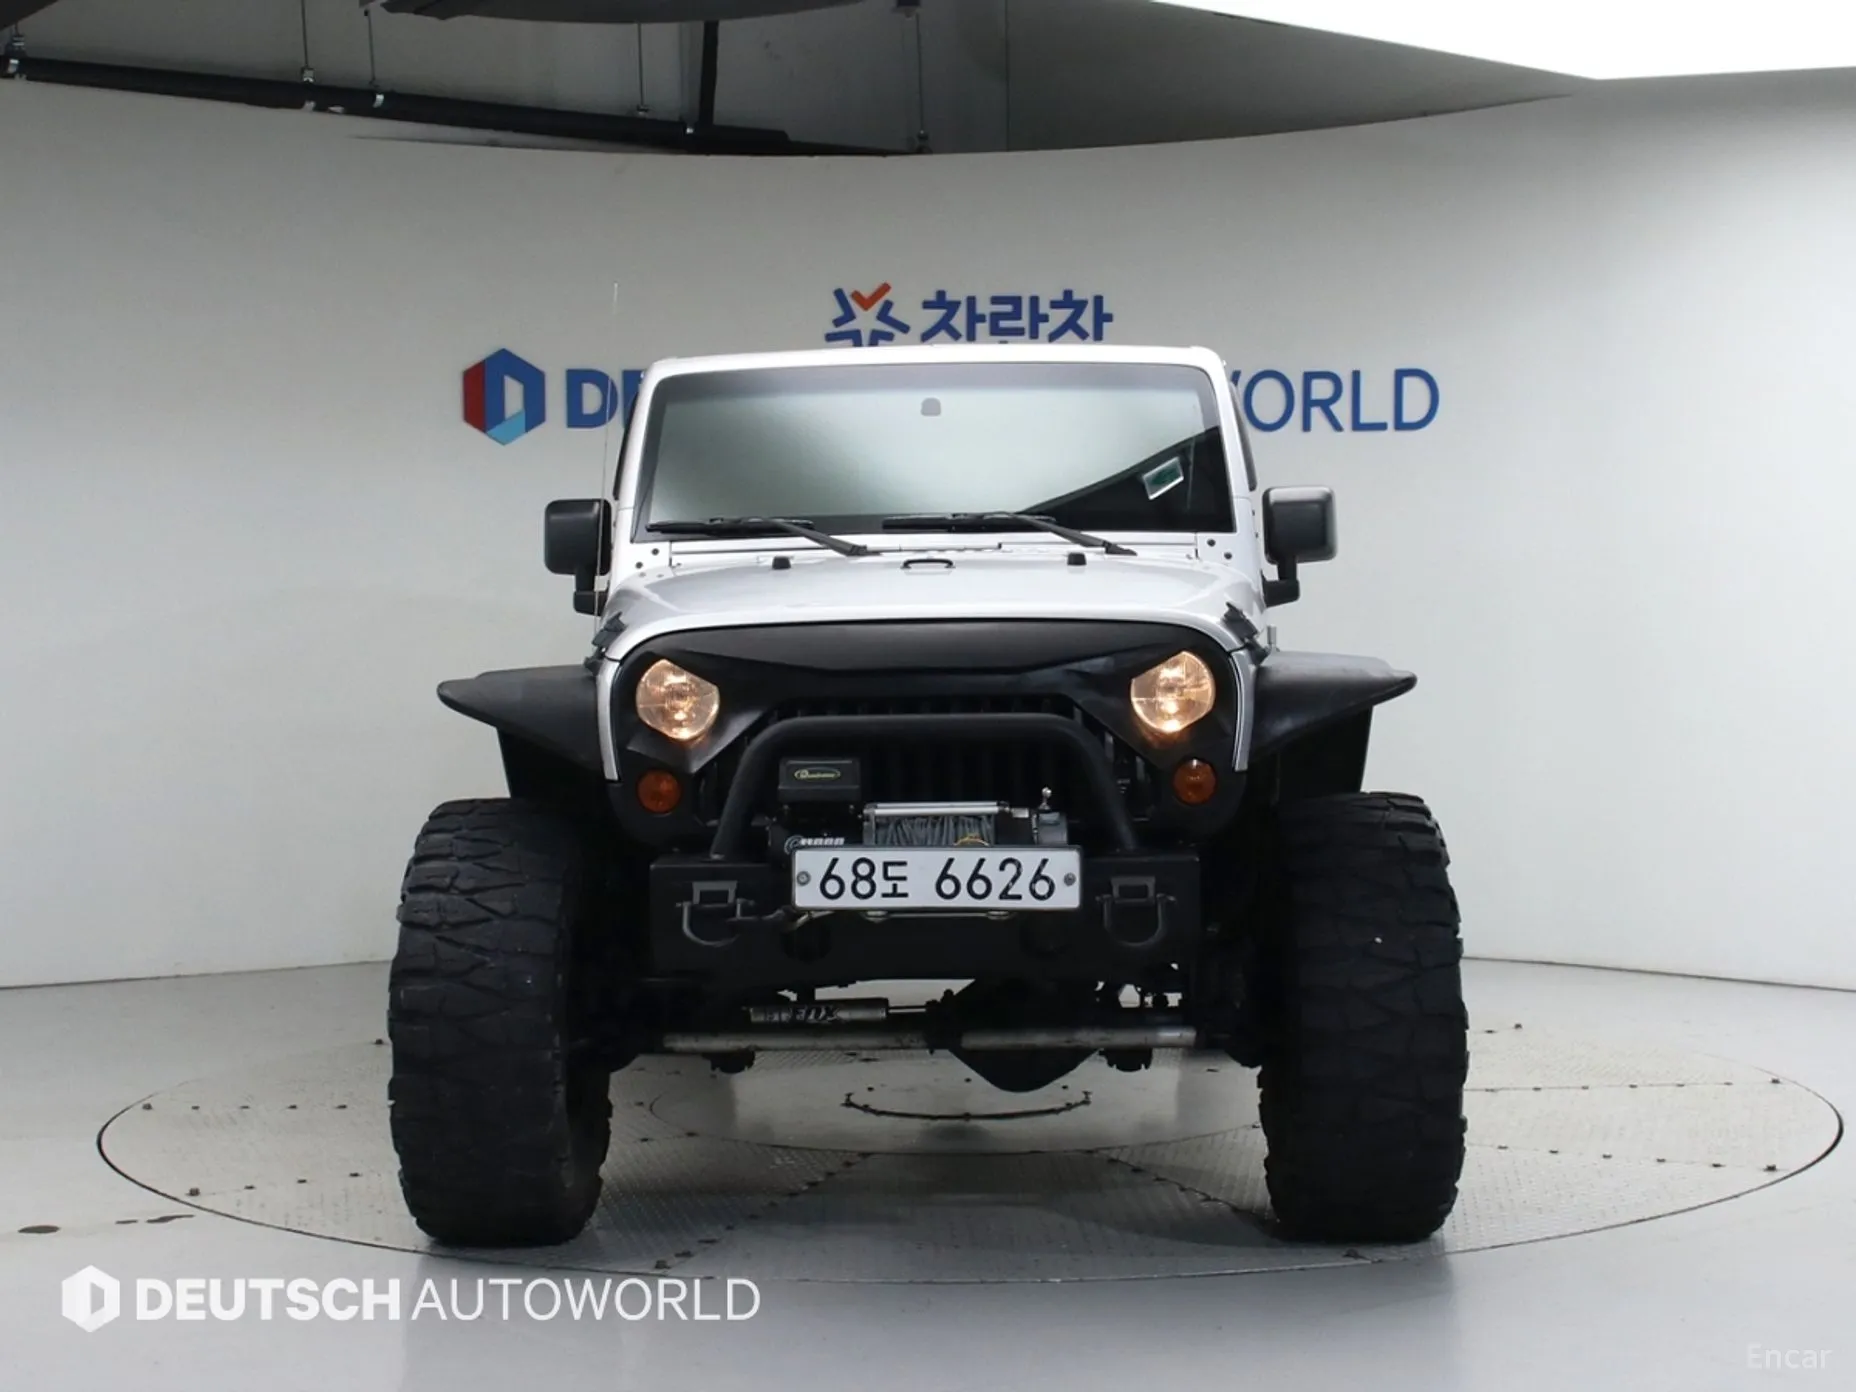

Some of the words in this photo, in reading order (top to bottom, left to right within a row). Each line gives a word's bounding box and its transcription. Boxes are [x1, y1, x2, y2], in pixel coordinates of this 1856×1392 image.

[1230, 368, 1440, 432] ORLD
[819, 857, 909, 900] 68도
[935, 857, 1056, 900] 6626
